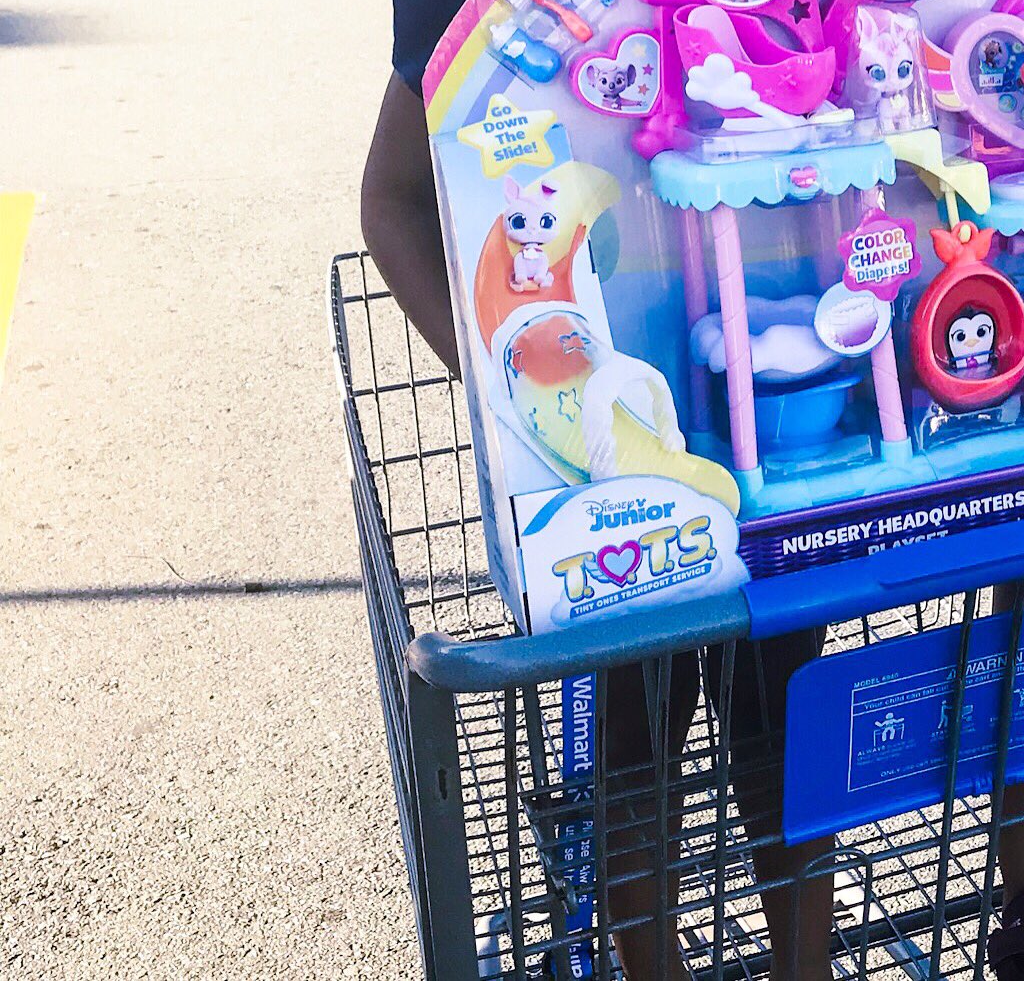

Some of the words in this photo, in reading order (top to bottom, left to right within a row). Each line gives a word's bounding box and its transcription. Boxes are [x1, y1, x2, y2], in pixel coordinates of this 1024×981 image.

[491, 106, 512, 118] Go
[483, 115, 529, 133] Down
[495, 130, 525, 145] The
[493, 142, 538, 161] Slide!
[854, 230, 906, 251] COLOR
[850, 246, 912, 268] CHANGE
[857, 262, 909, 282] Diapers!
[590, 499, 676, 531] Junior
[782, 521, 873, 555] NURSERY
[574, 603, 594, 615] TINY
[596, 593, 619, 607] ONES
[621, 576, 669, 598] TRANSPORT
[671, 566, 706, 583] SERVICE
[572, 675, 593, 772] Walmart
